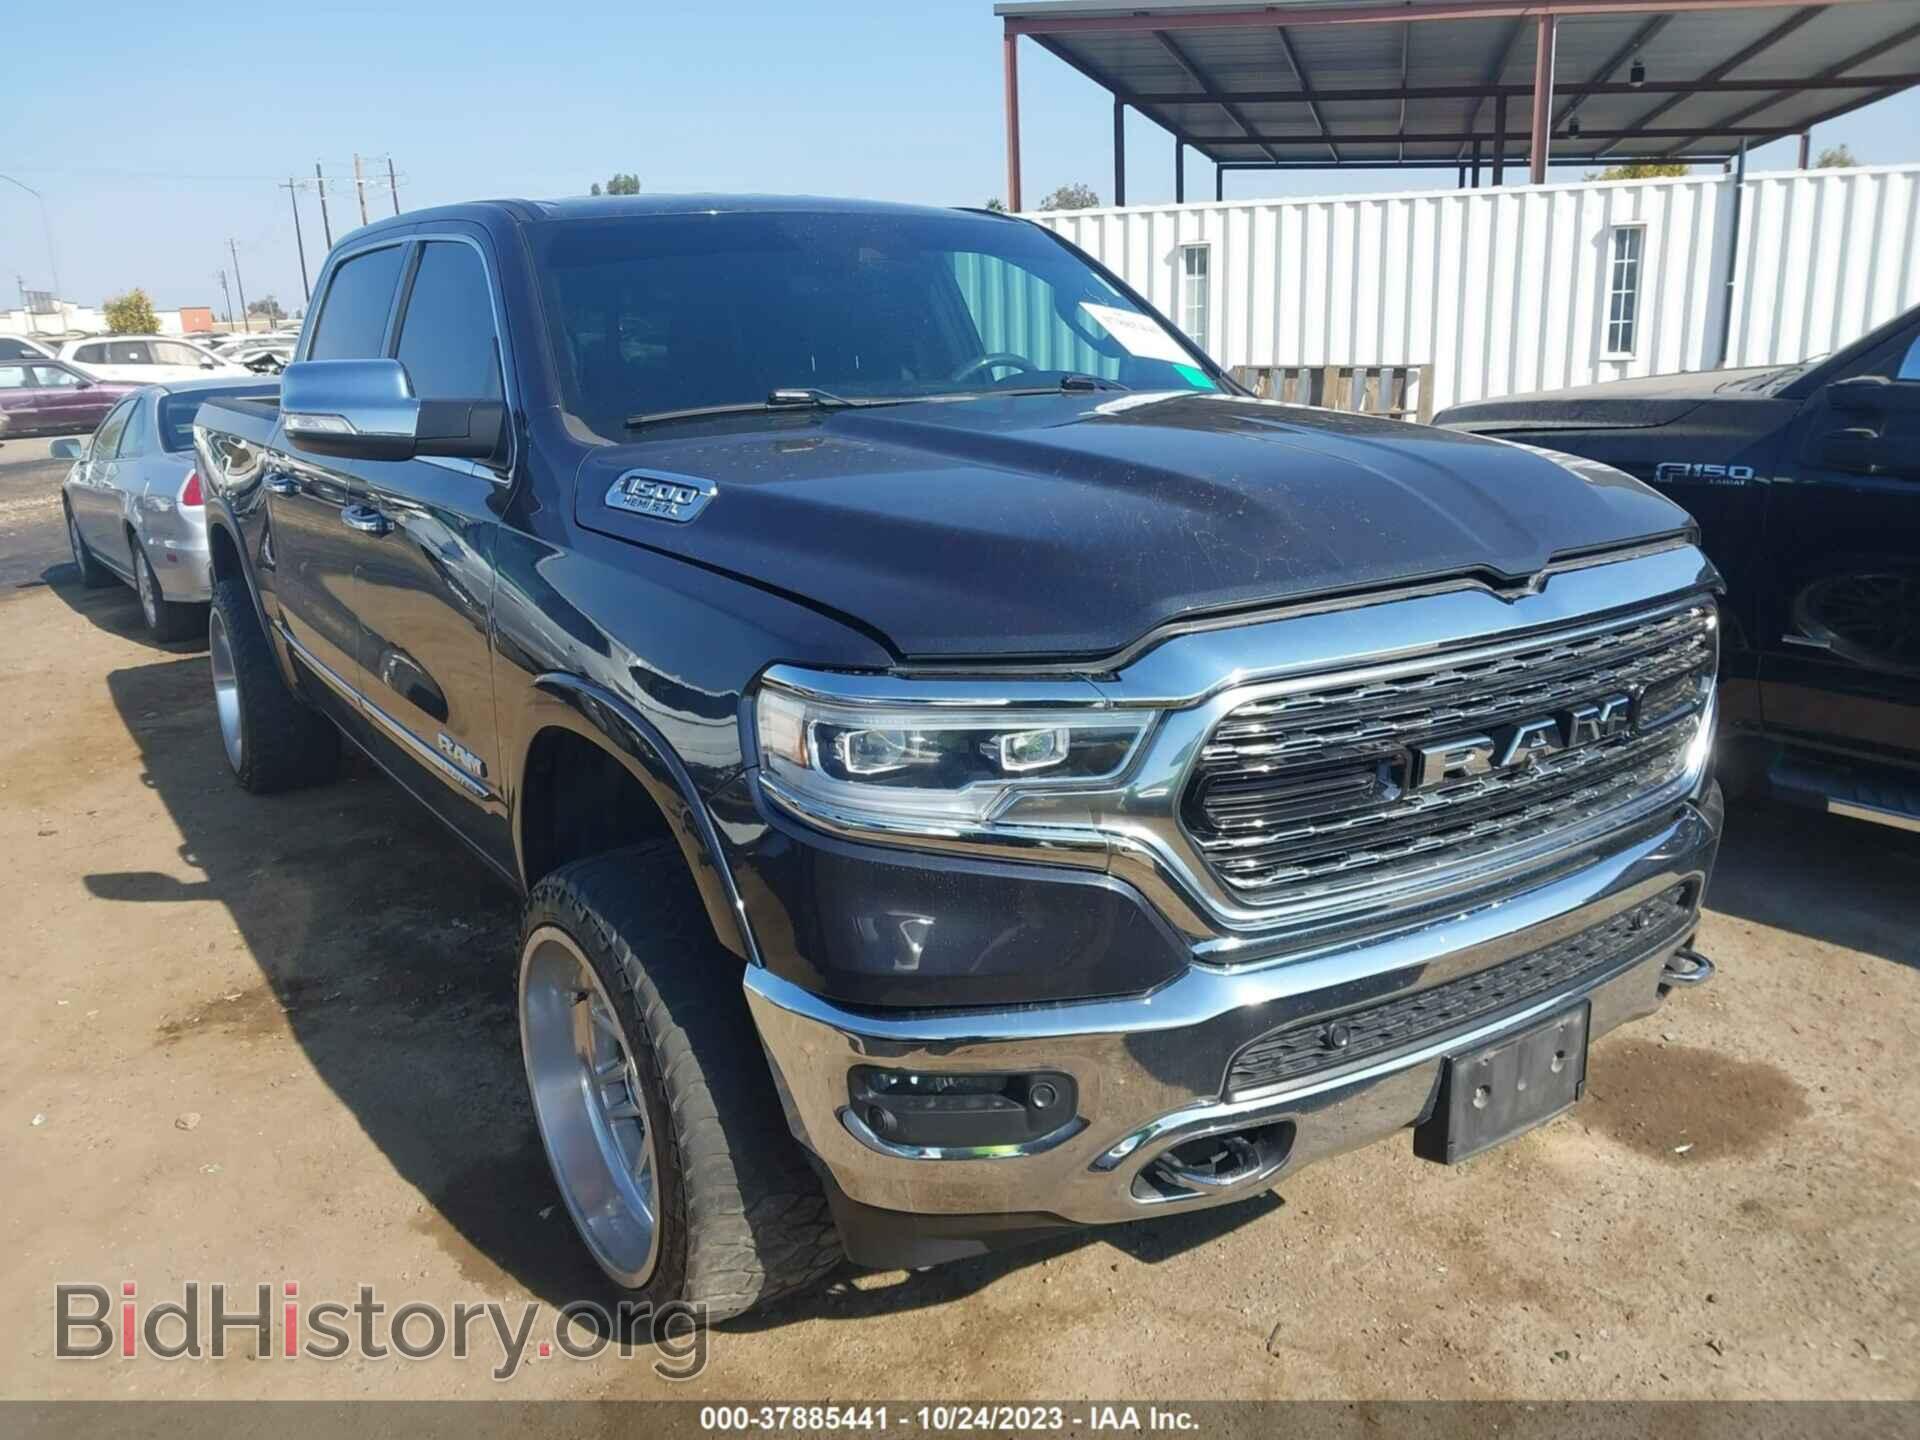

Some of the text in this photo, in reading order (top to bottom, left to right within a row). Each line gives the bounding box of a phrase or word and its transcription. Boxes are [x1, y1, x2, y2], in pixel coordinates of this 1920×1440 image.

[623, 495, 650, 510] HEMI
[624, 477, 698, 505] 1500
[437, 732, 484, 779] RAM
[1420, 695, 1631, 787] RAM
